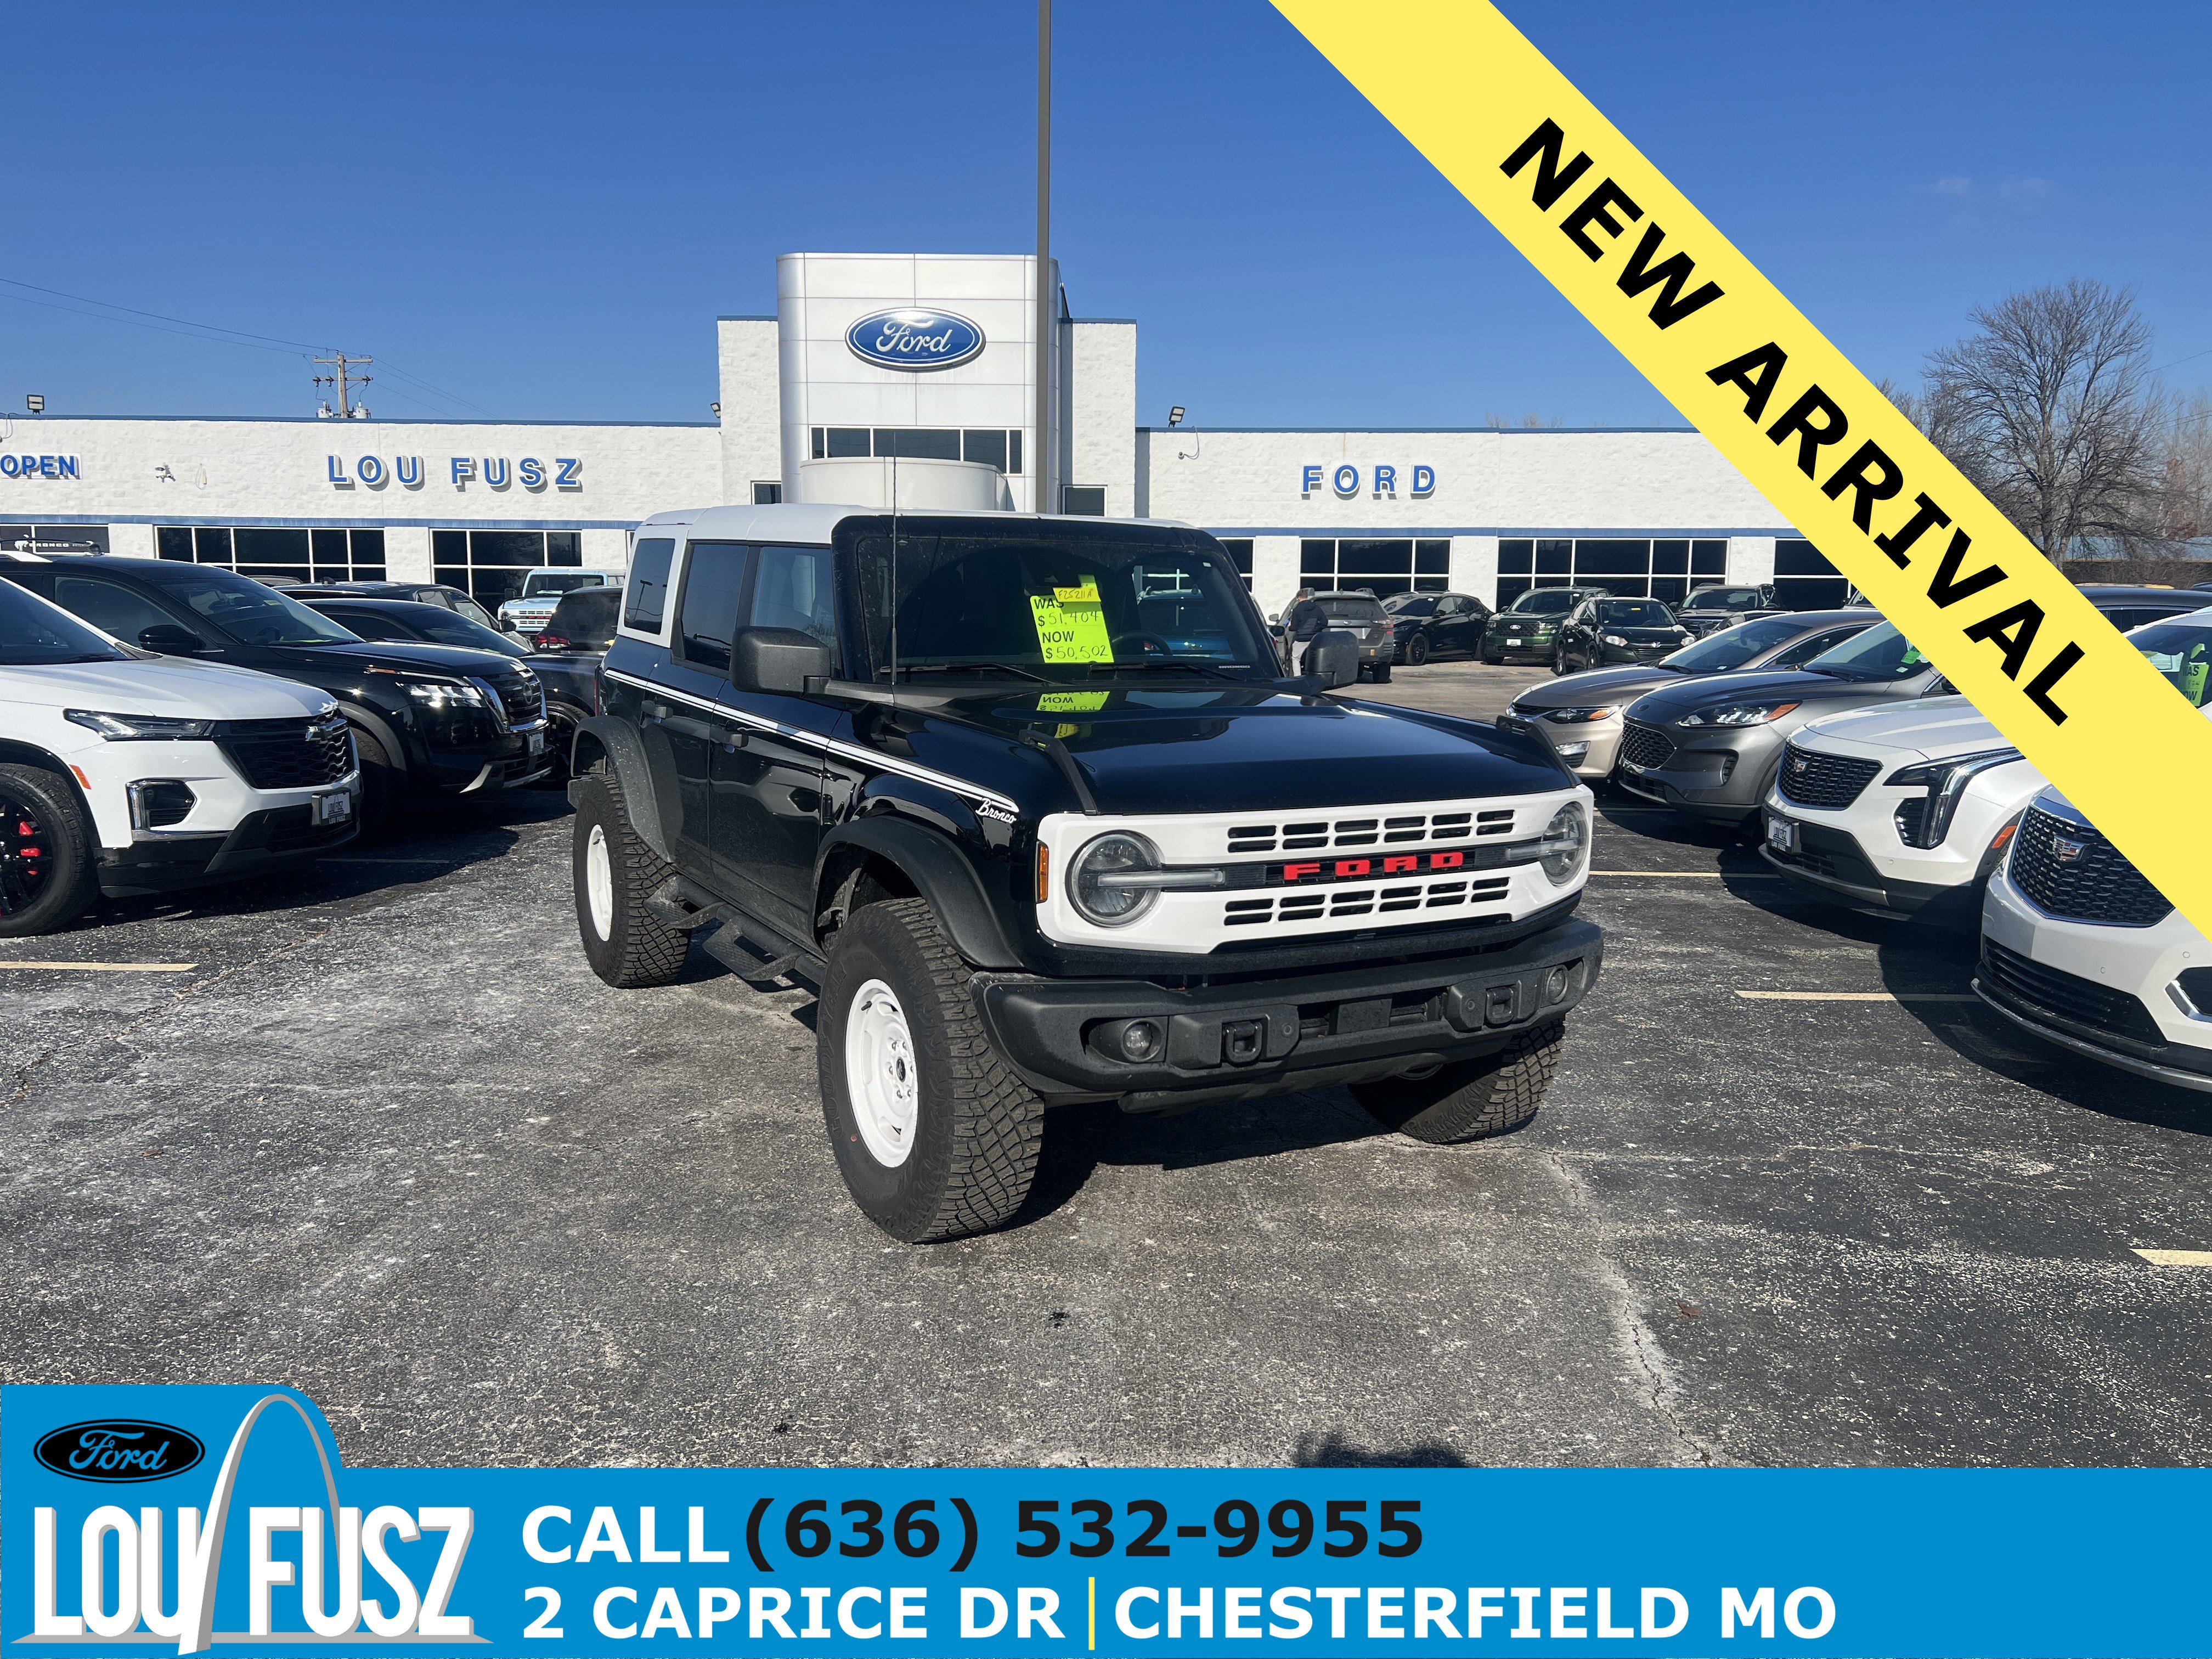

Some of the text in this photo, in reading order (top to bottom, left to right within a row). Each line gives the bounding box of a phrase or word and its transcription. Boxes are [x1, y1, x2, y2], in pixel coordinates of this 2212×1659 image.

[876, 319, 953, 352] Ford
[0, 455, 76, 476] OPEN
[329, 455, 577, 486] LOU FUSZ
[1303, 464, 1435, 493] FORD
[1034, 598, 1064, 610] WAS
[1042, 631, 1075, 644] NOW
[975, 797, 1017, 824] Bronco
[1284, 851, 1464, 881] FORD
